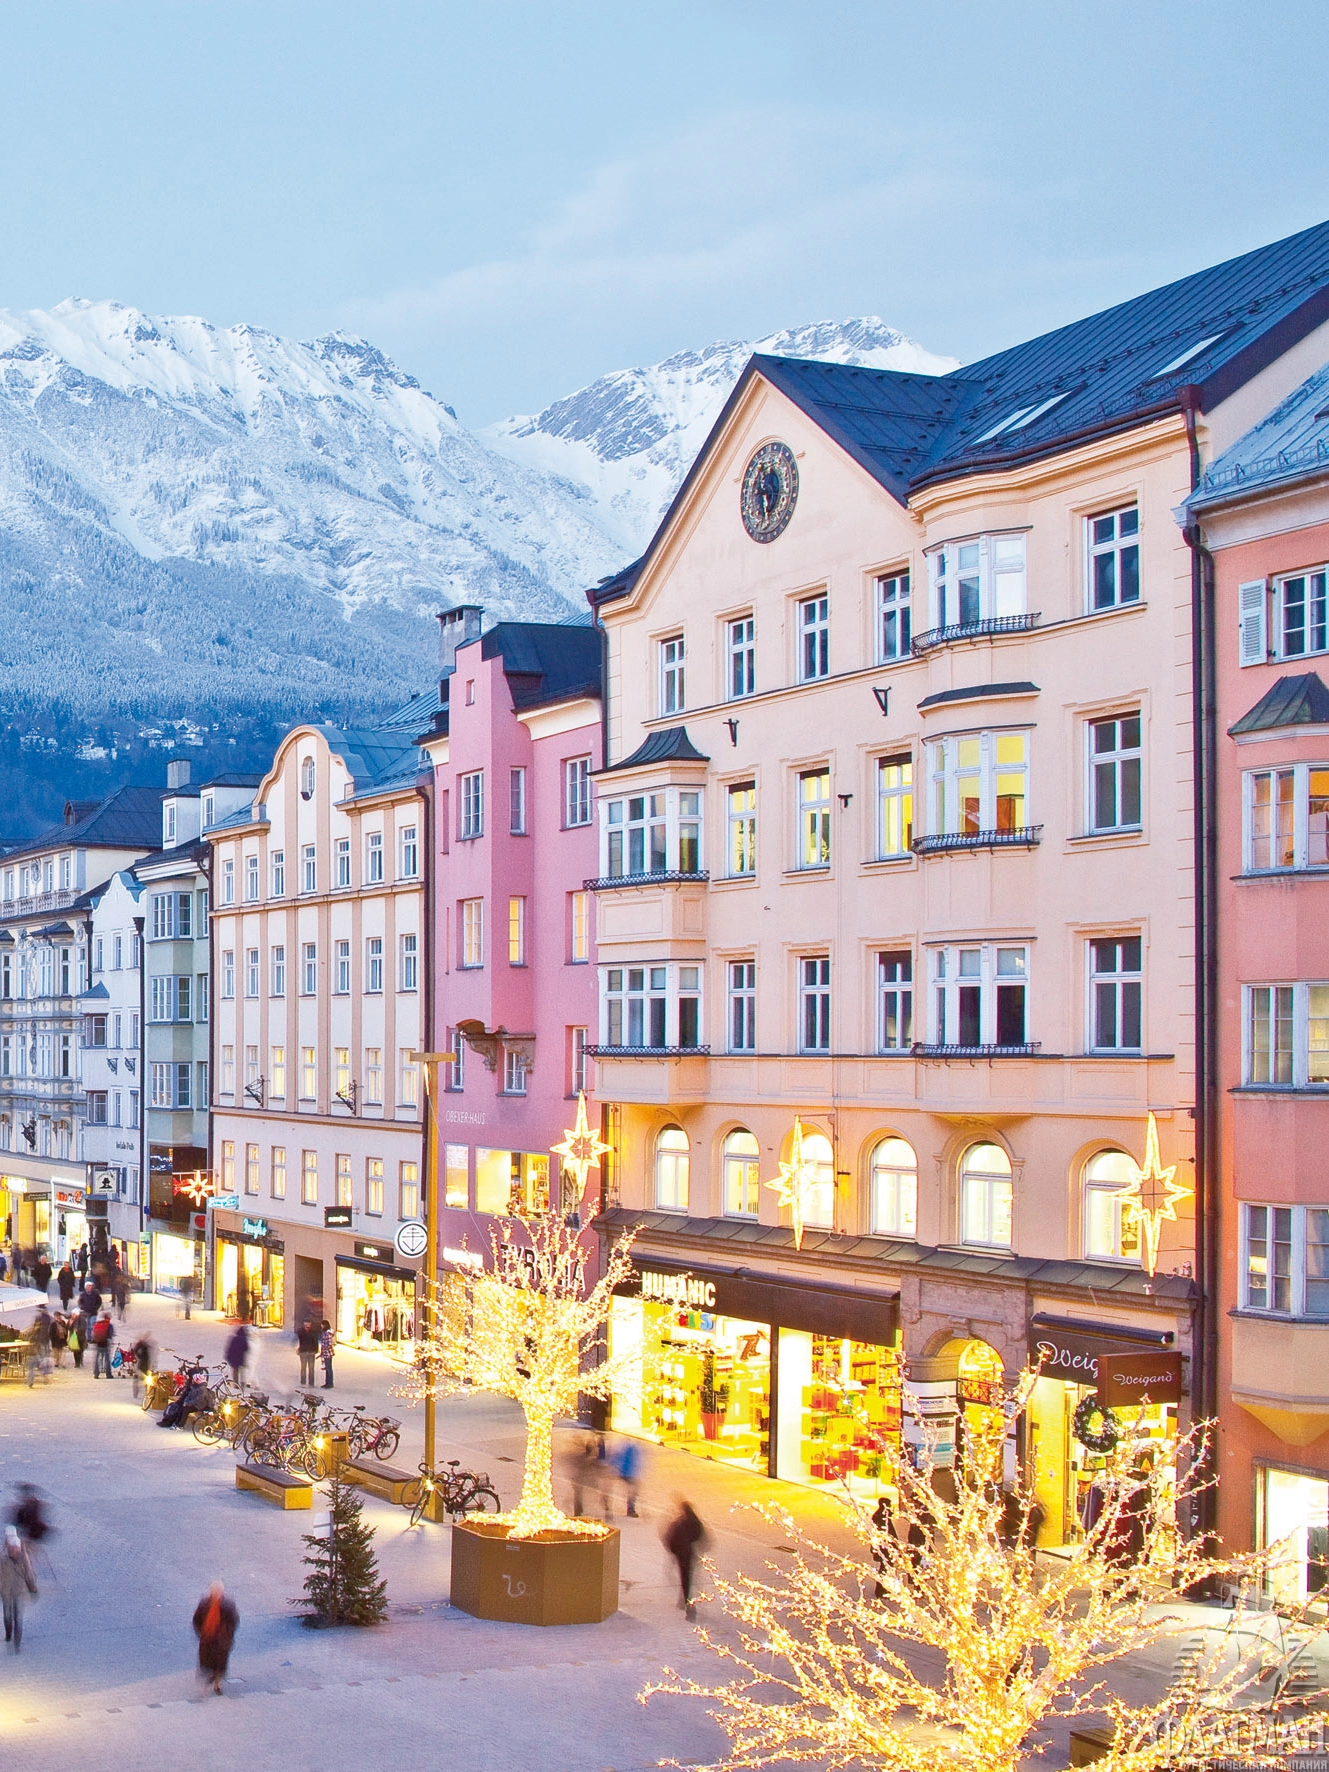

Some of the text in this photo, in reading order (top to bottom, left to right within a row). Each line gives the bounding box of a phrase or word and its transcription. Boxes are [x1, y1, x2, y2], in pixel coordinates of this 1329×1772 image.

[642, 1271, 717, 1308] HUMANIC
[1036, 1340, 1099, 1379] Weig
[1112, 1371, 1176, 1387] Weigand
